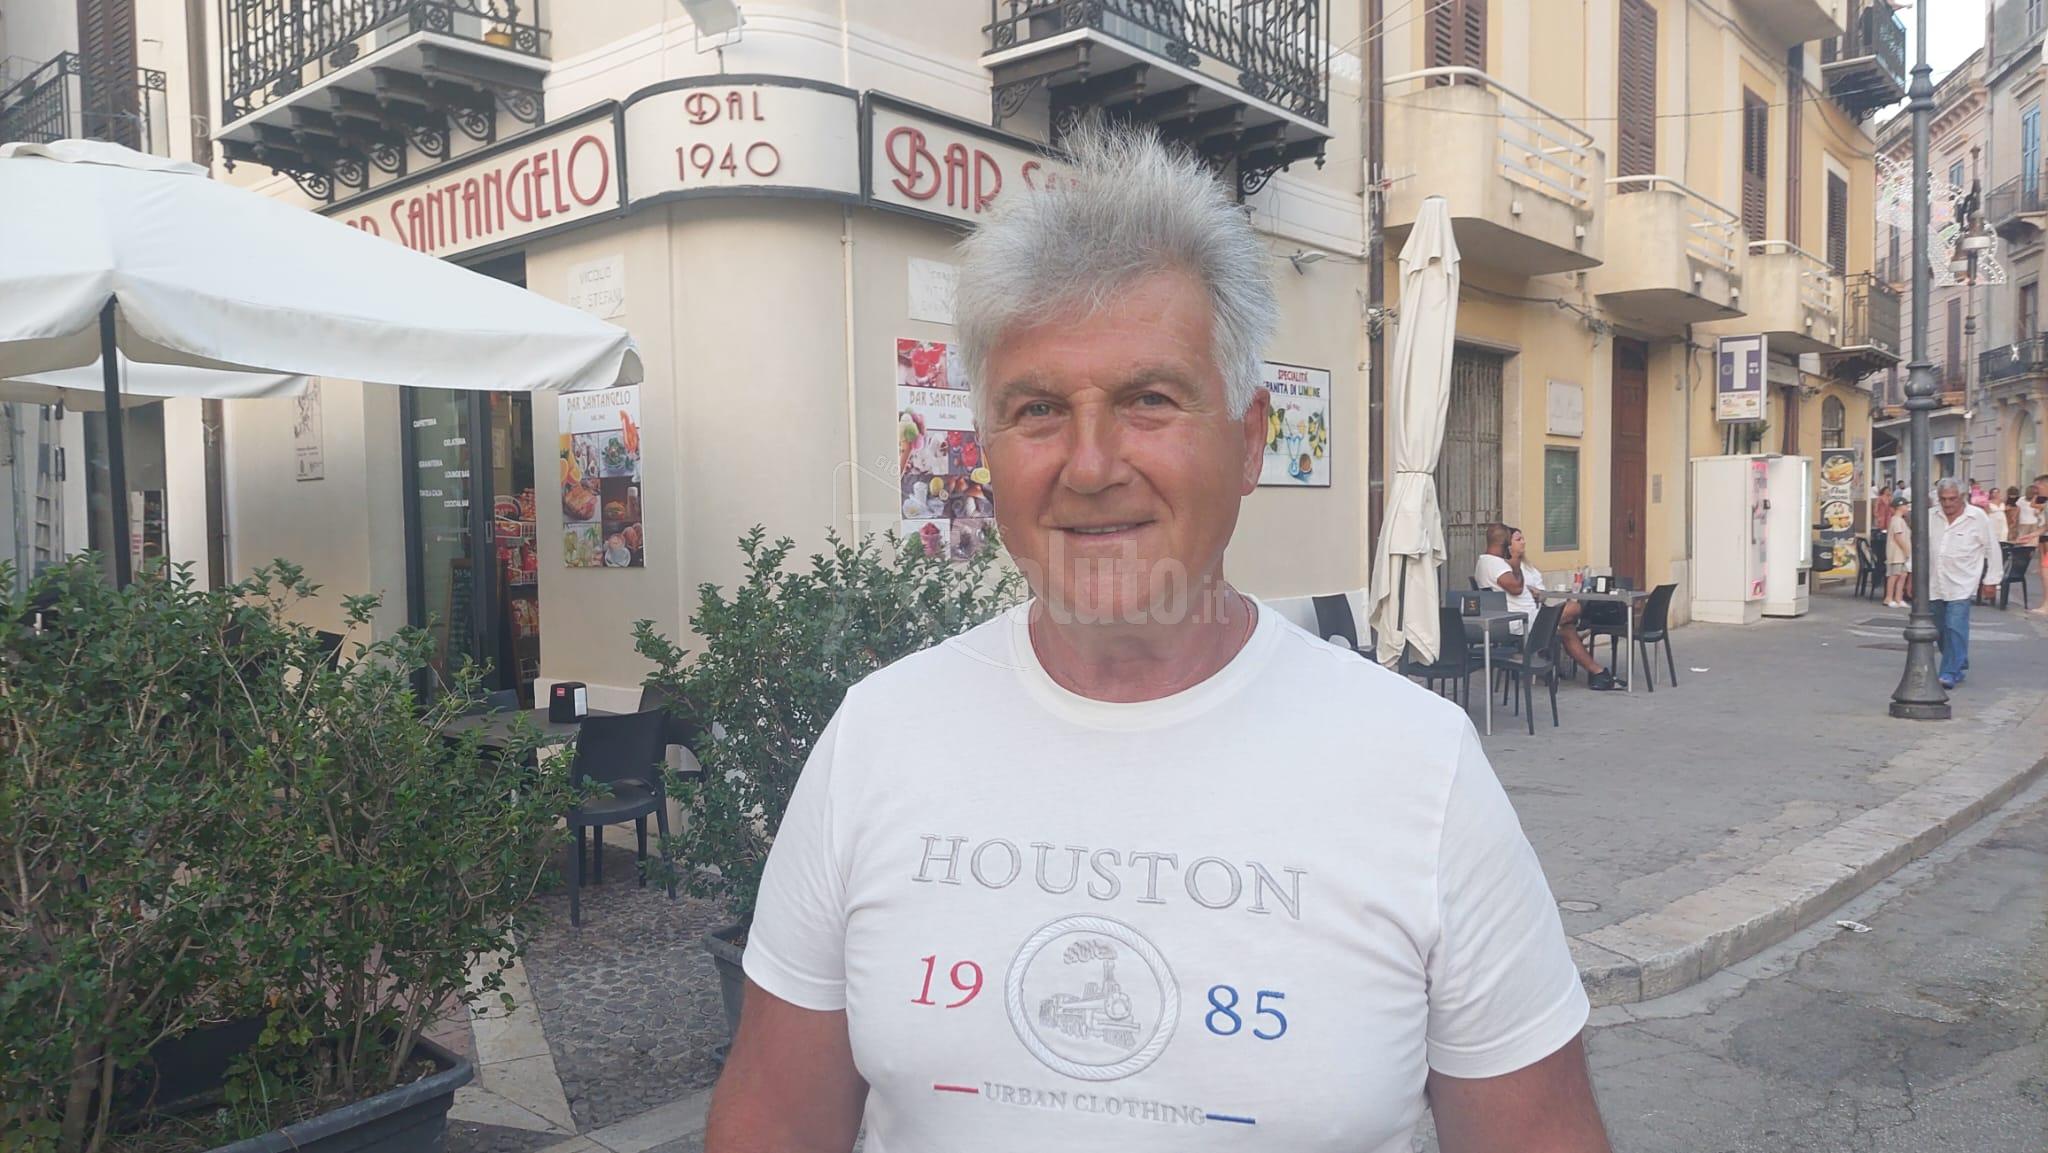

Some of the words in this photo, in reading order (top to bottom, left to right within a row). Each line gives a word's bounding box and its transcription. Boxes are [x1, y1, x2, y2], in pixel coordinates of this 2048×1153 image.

[685, 91, 765, 125] DAL
[675, 141, 781, 182] 1940
[885, 126, 1002, 214] BAR
[390, 135, 610, 253] SANTANGELO
[582, 390, 631, 410] SANTANGELO
[929, 391, 969, 408] SANTANG
[911, 832, 1308, 921] HOUSTON
[910, 954, 984, 1009] 19
[1204, 984, 1288, 1041] 85
[983, 1081, 1068, 1111] URBAN
[1072, 1093, 1206, 1127] CLOTHING
